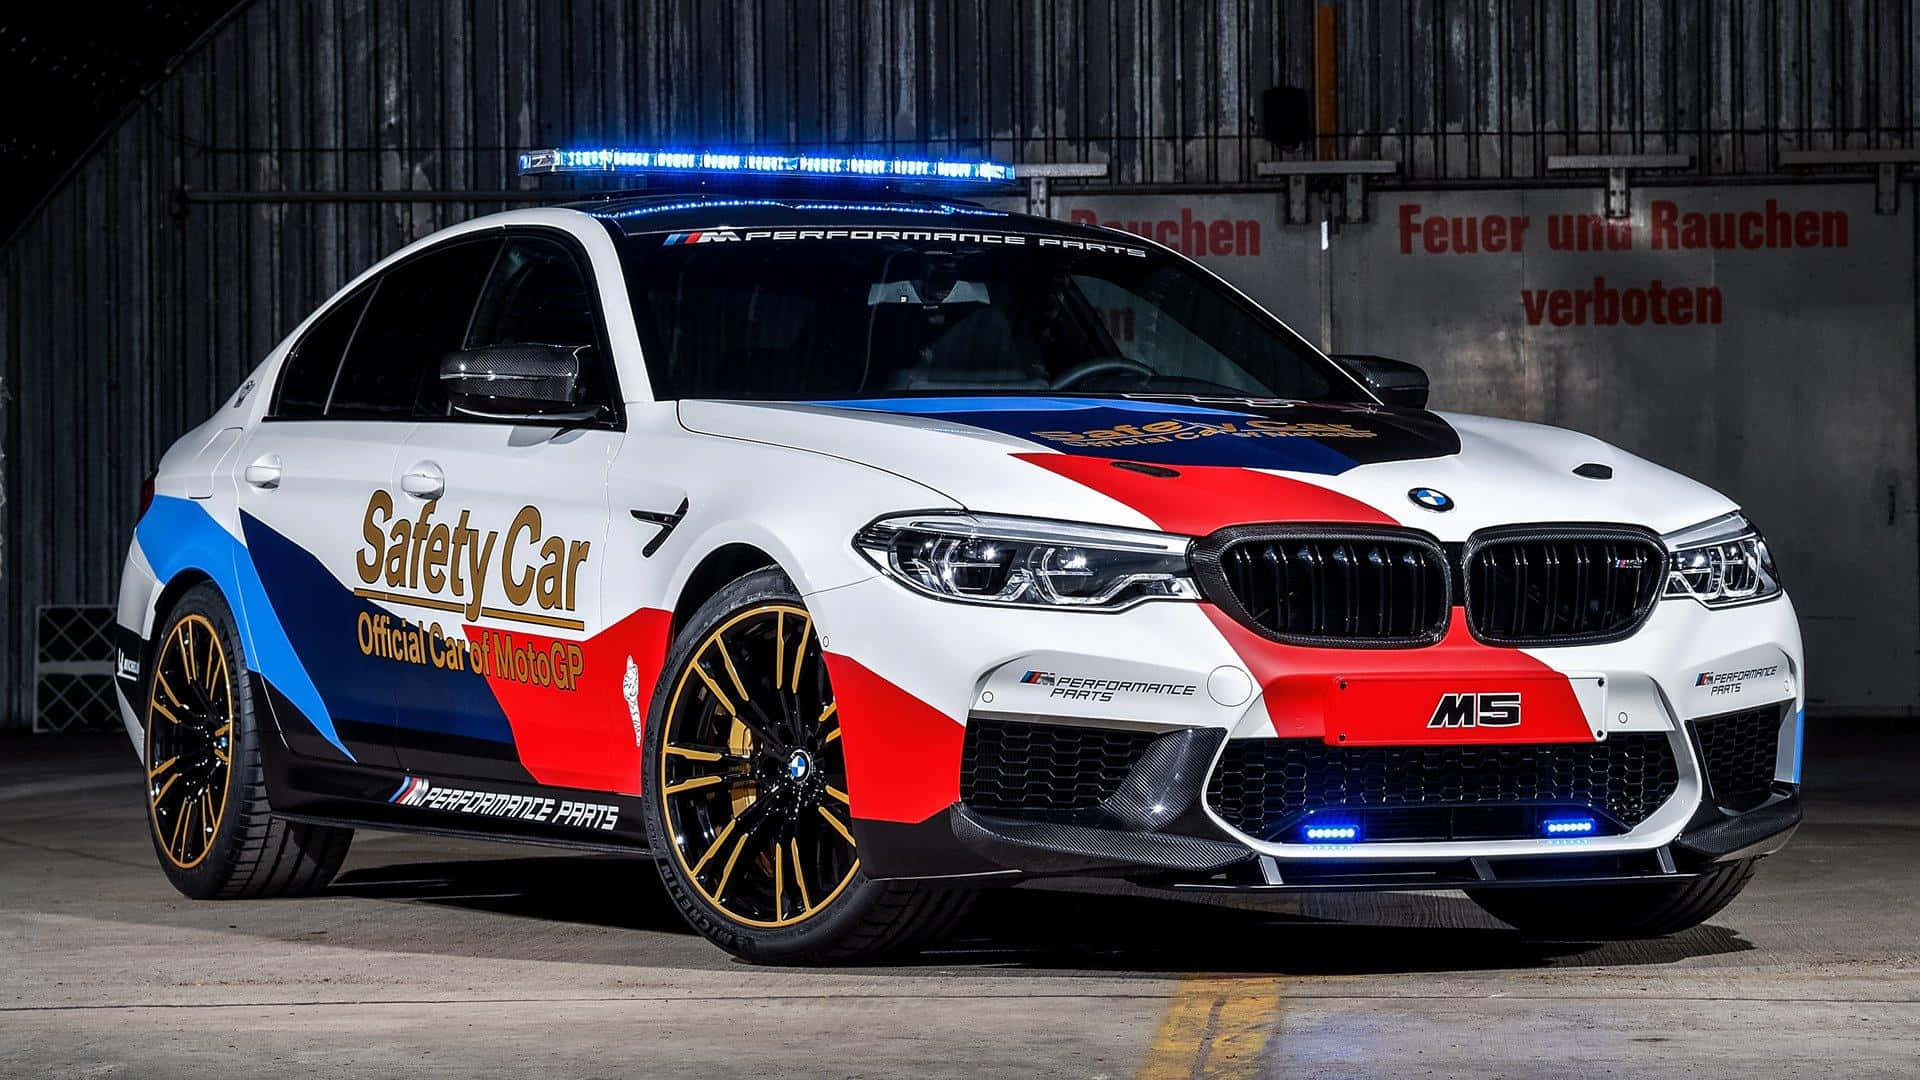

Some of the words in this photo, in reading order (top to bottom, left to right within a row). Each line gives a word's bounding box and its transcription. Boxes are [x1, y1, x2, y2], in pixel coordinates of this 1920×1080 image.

[745, 230, 1025, 245] PERFORMANCE
[1039, 238, 1146, 258] PARTS
[1398, 204, 1531, 254] Feuer
[1547, 212, 1633, 252] und
[1650, 199, 1850, 251] Rauchen
[1520, 276, 1724, 327] verboten
[356, 489, 498, 622] Safety
[502, 505, 591, 611] Car
[357, 611, 427, 665] Official
[429, 621, 466, 671] Car
[469, 631, 491, 676] of
[493, 632, 584, 691] MotoGP
[1056, 676, 1197, 697] PERFORMANCE
[1711, 682, 1742, 696] PARTS
[1713, 665, 1778, 685] PERFORMANCE
[1050, 687, 1114, 702] PARTS
[1427, 692, 1521, 728] M5
[418, 787, 556, 822] PERFORMANCE
[552, 800, 619, 831] PARTS
